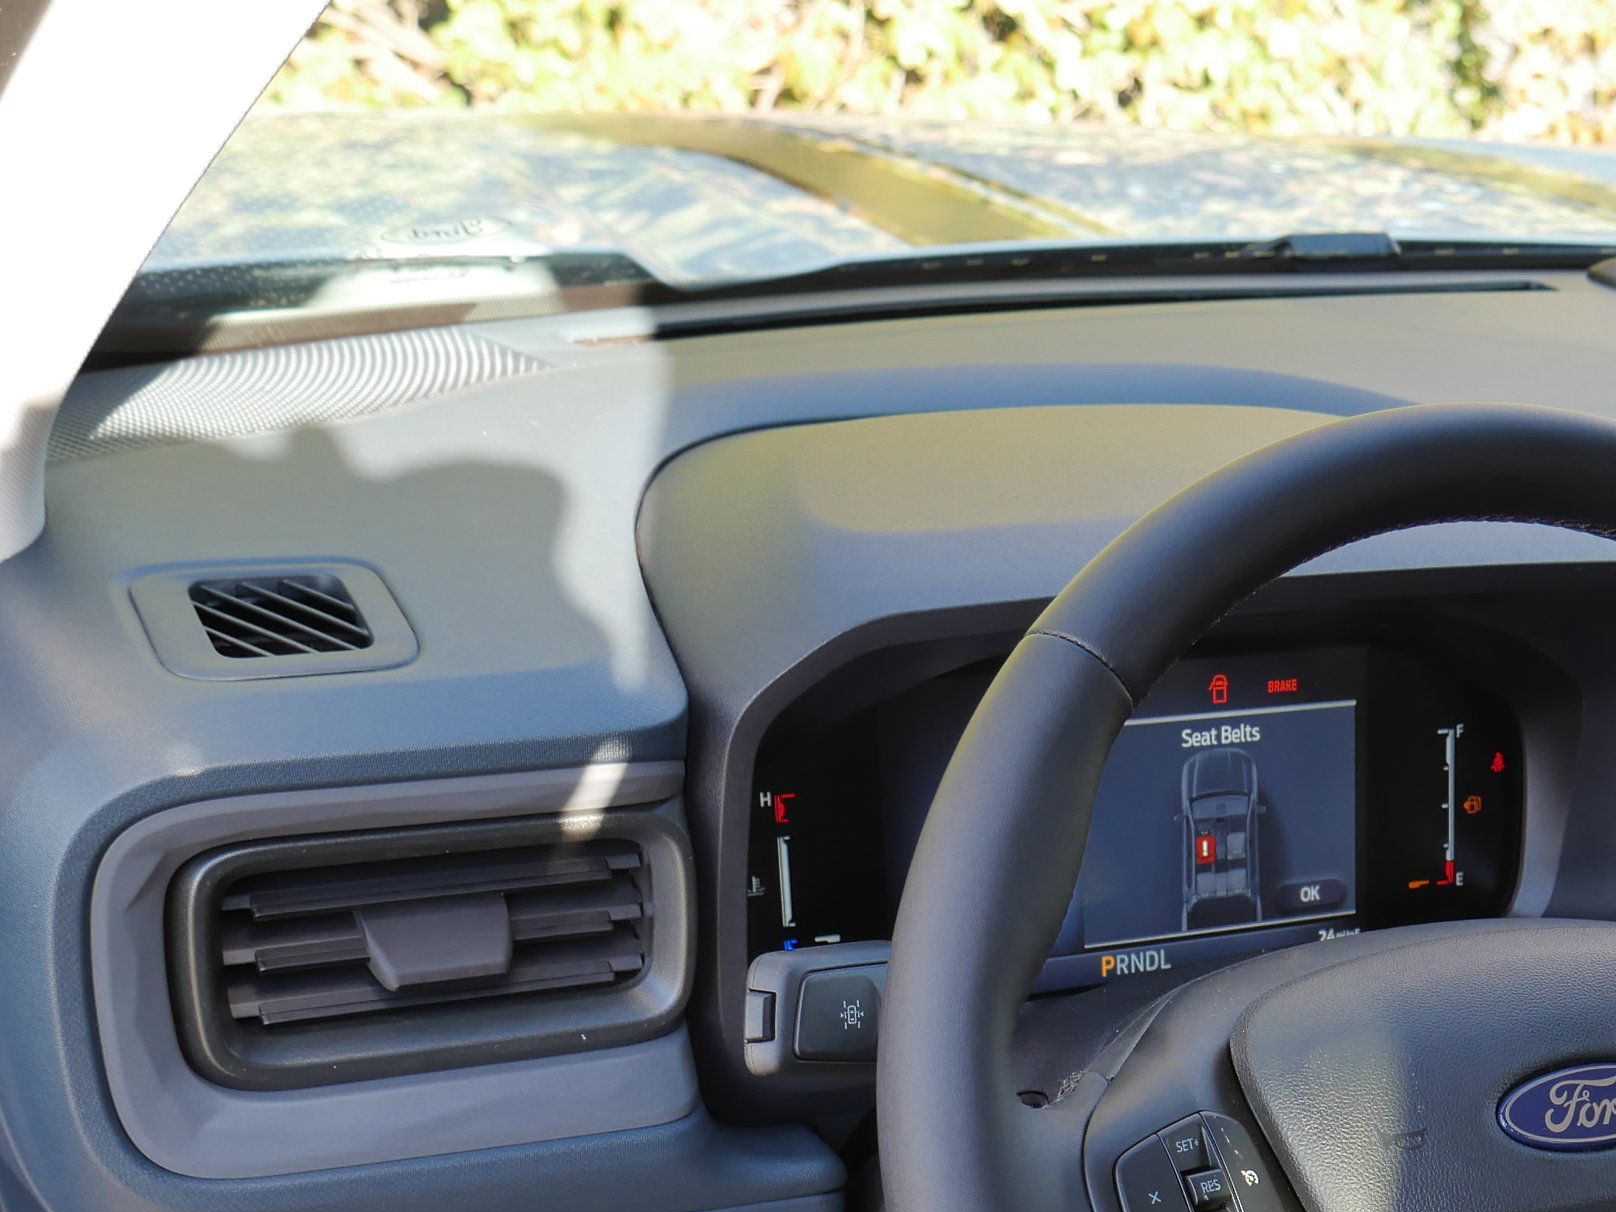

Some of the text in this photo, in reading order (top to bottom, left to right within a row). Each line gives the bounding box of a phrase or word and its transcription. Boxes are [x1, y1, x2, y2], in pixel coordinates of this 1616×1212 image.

[1267, 678, 1299, 693] BRAKE
[1181, 723, 1261, 748] Seat Belts
[1456, 724, 1464, 739] F
[760, 791, 772, 807] H
[1455, 872, 1464, 886] E
[1300, 886, 1320, 903] OK
[1200, 1179, 1221, 1194] RES
